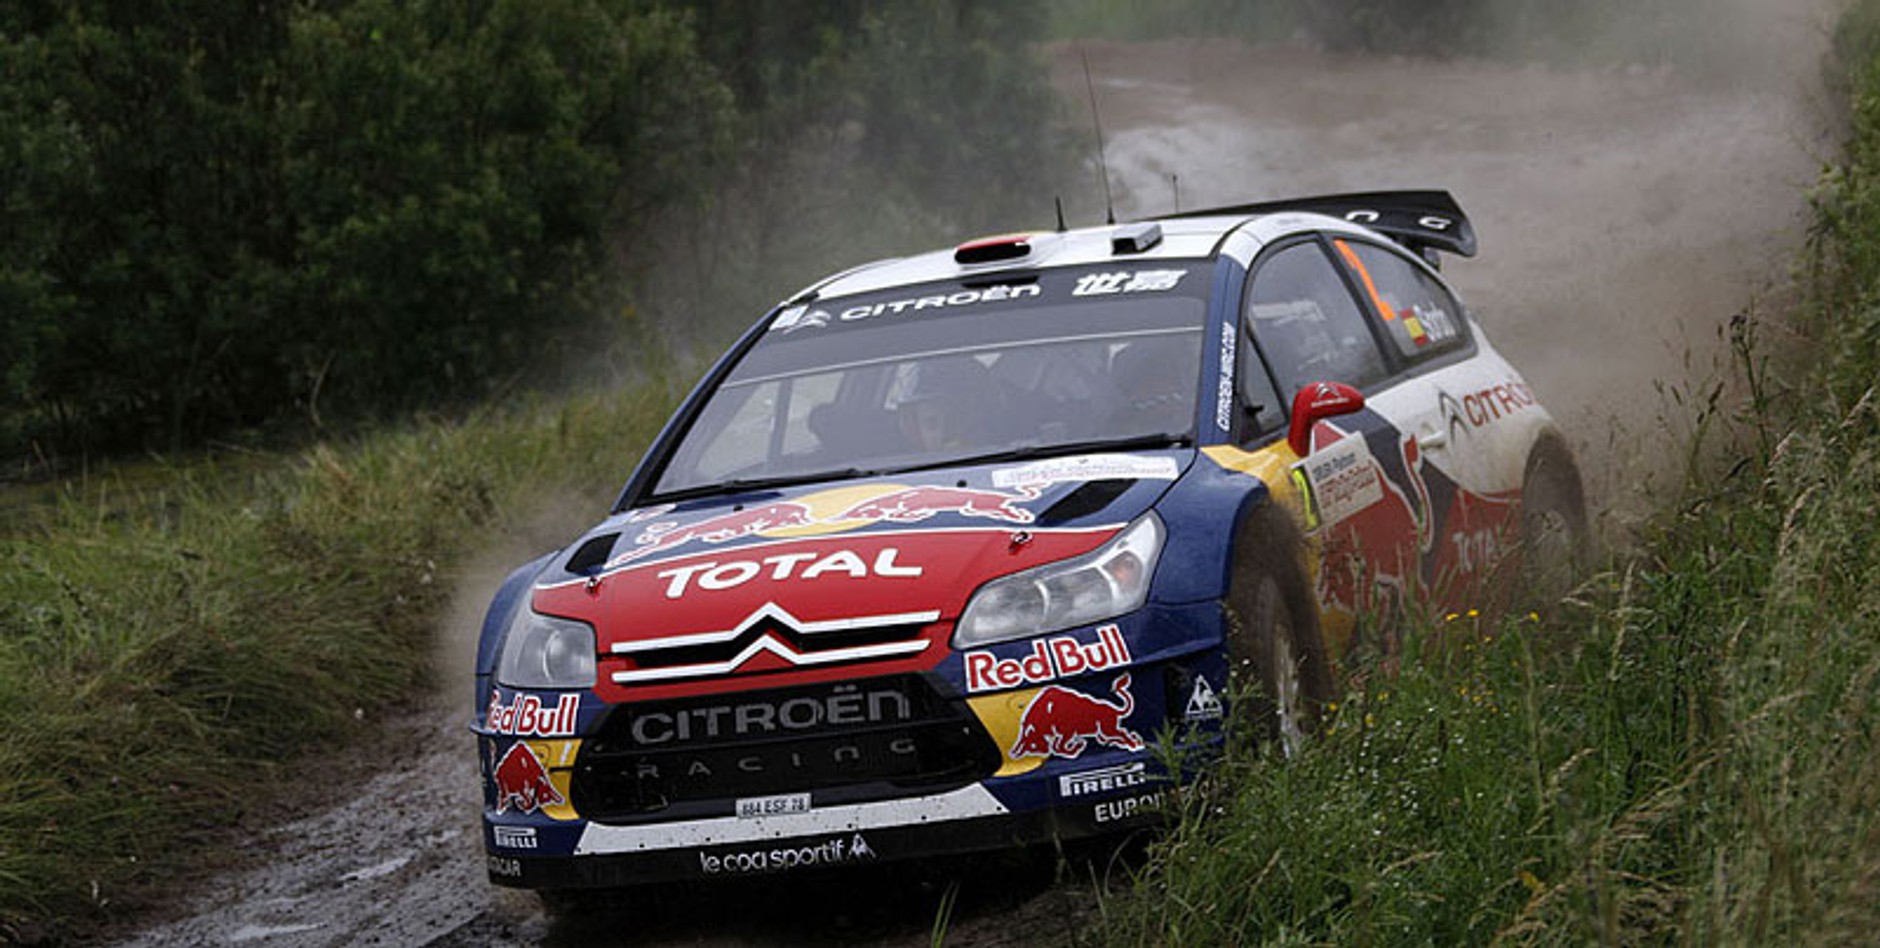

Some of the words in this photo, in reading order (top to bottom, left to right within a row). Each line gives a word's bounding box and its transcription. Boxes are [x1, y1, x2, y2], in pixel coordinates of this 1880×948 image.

[657, 547, 923, 599] TOTAL
[963, 639, 1054, 693] Red
[1049, 623, 1132, 678] Bull
[515, 694, 579, 737] Bull
[1060, 762, 1146, 797] PIRELLI
[700, 851, 721, 873] le
[770, 839, 845, 871] sportif
